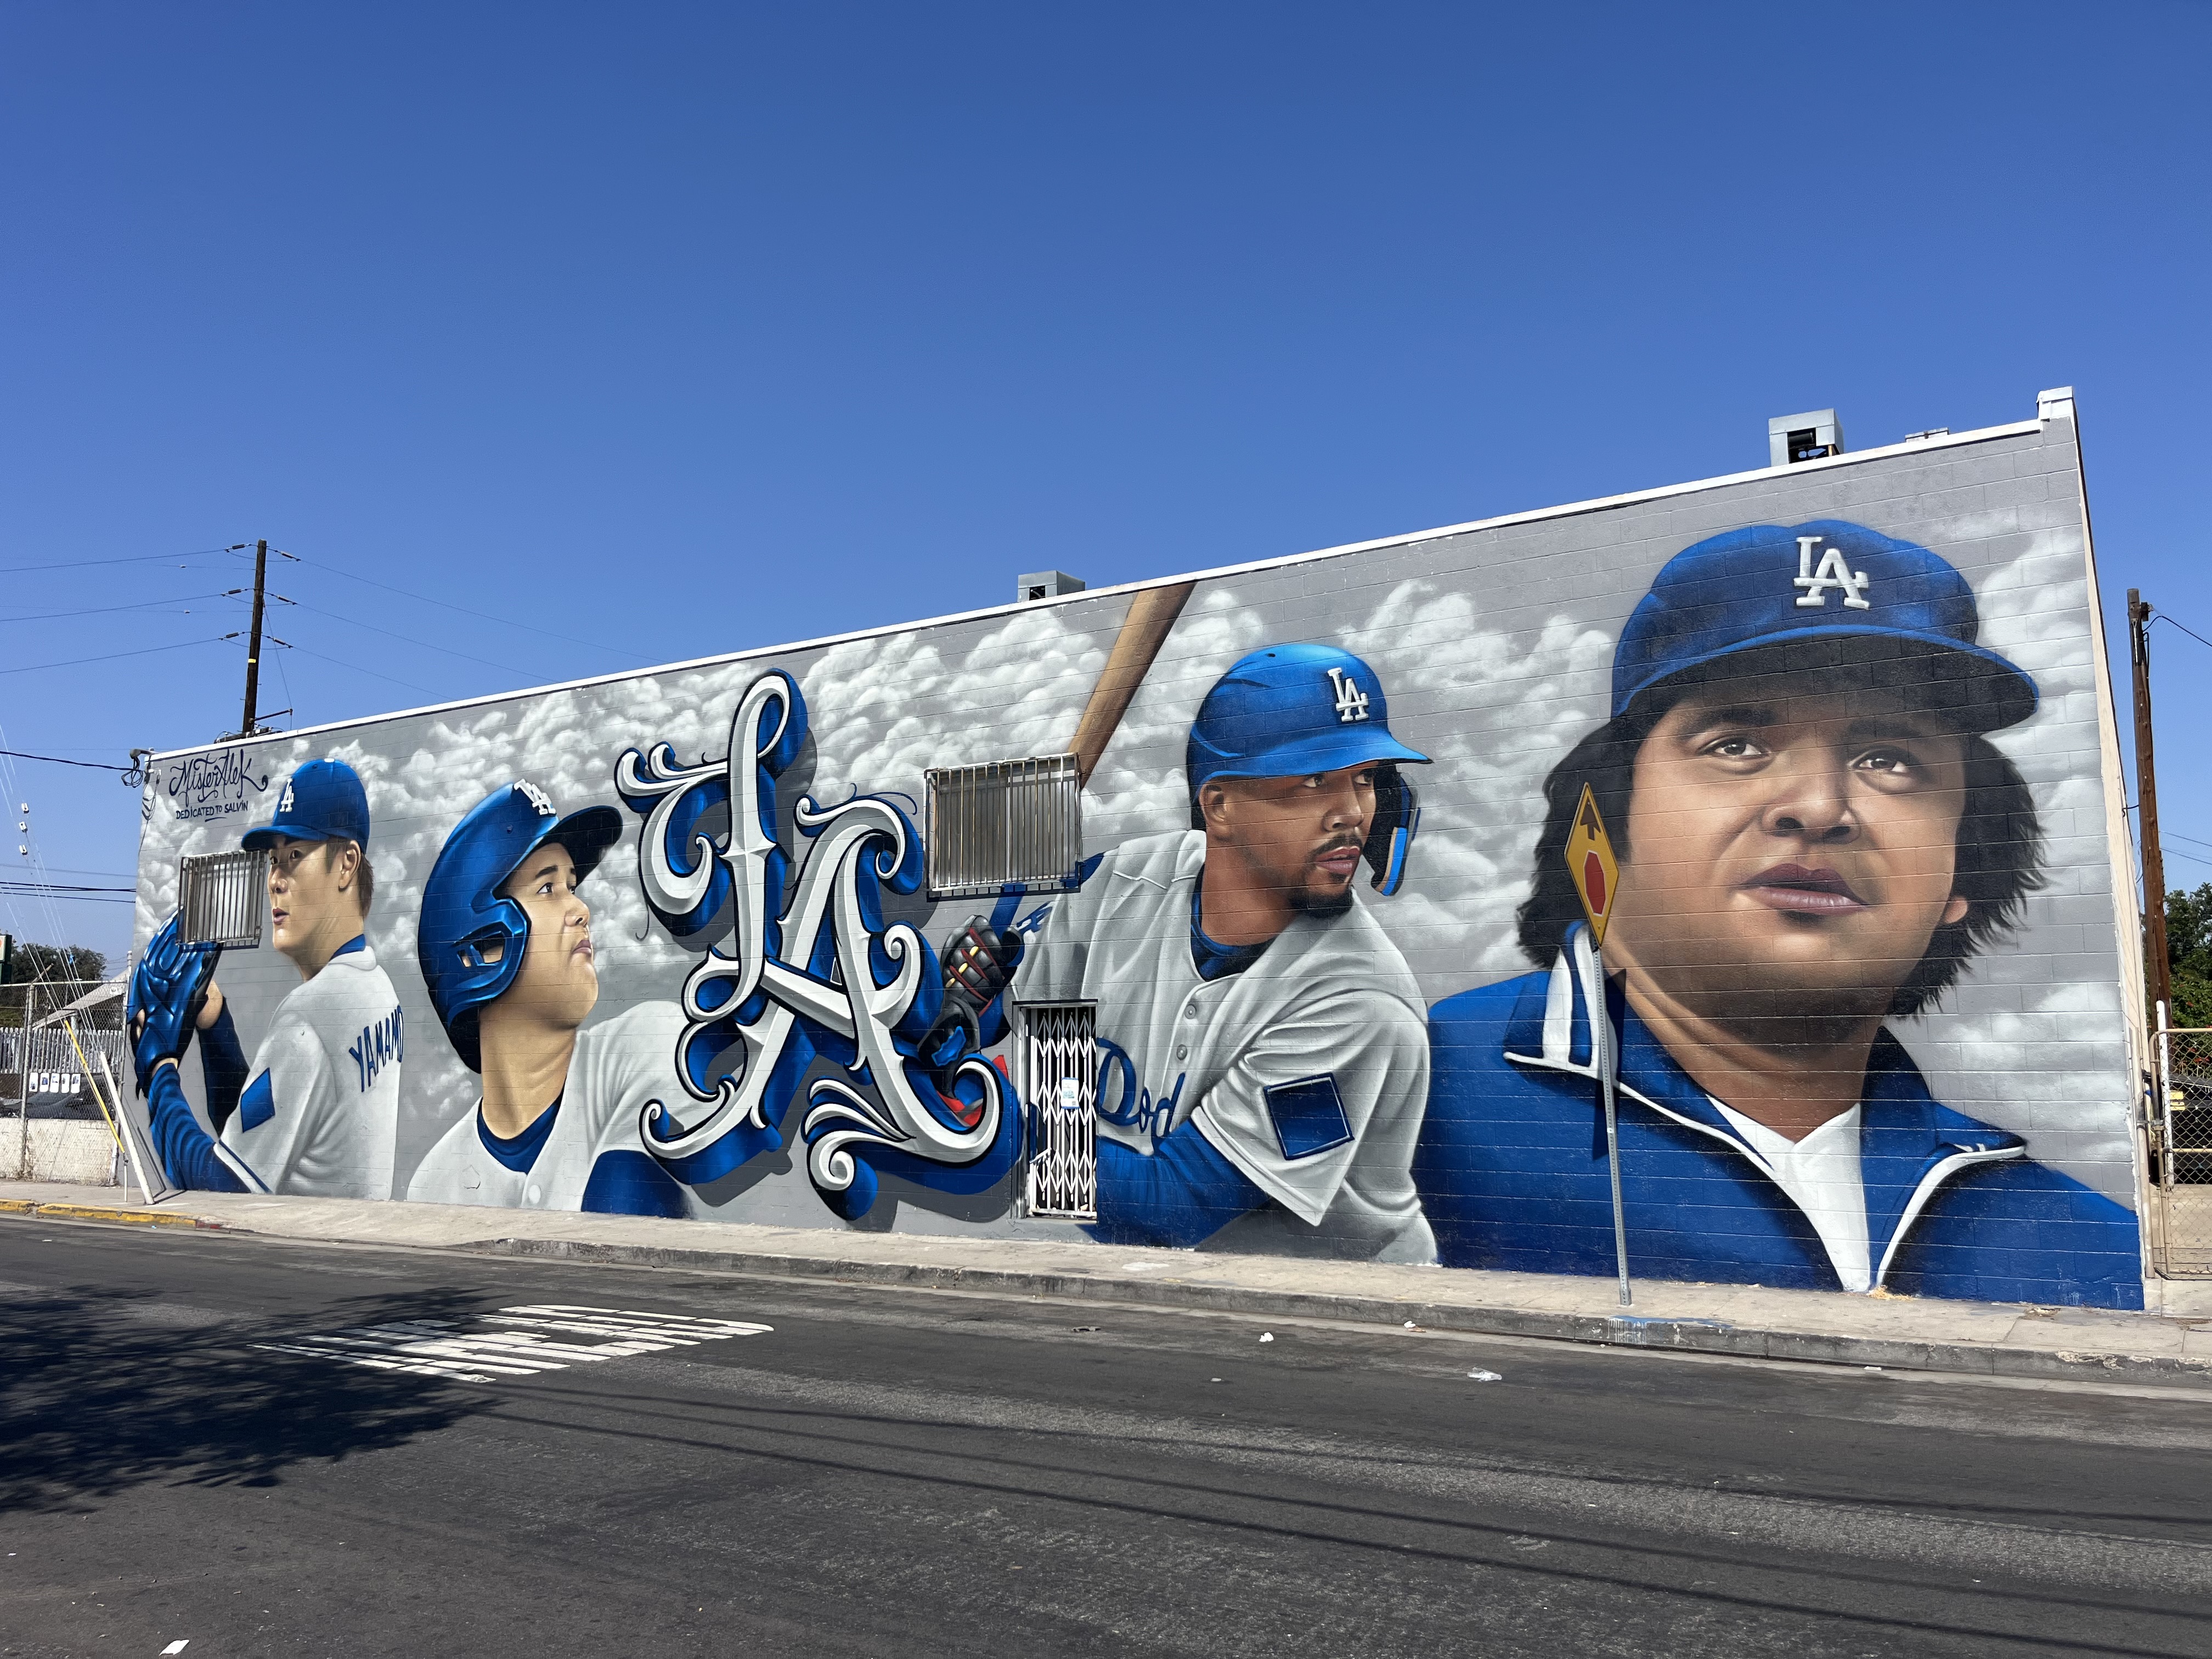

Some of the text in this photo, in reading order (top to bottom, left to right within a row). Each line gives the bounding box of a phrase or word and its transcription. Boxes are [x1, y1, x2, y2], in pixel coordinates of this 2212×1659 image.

[1793, 537, 1870, 610] LA
[1327, 667, 1369, 722] LA
[215, 805, 223, 814] TO
[279, 778, 294, 812] LA
[514, 778, 556, 815] LA
[246, 1305, 774, 1383] AHEAD
